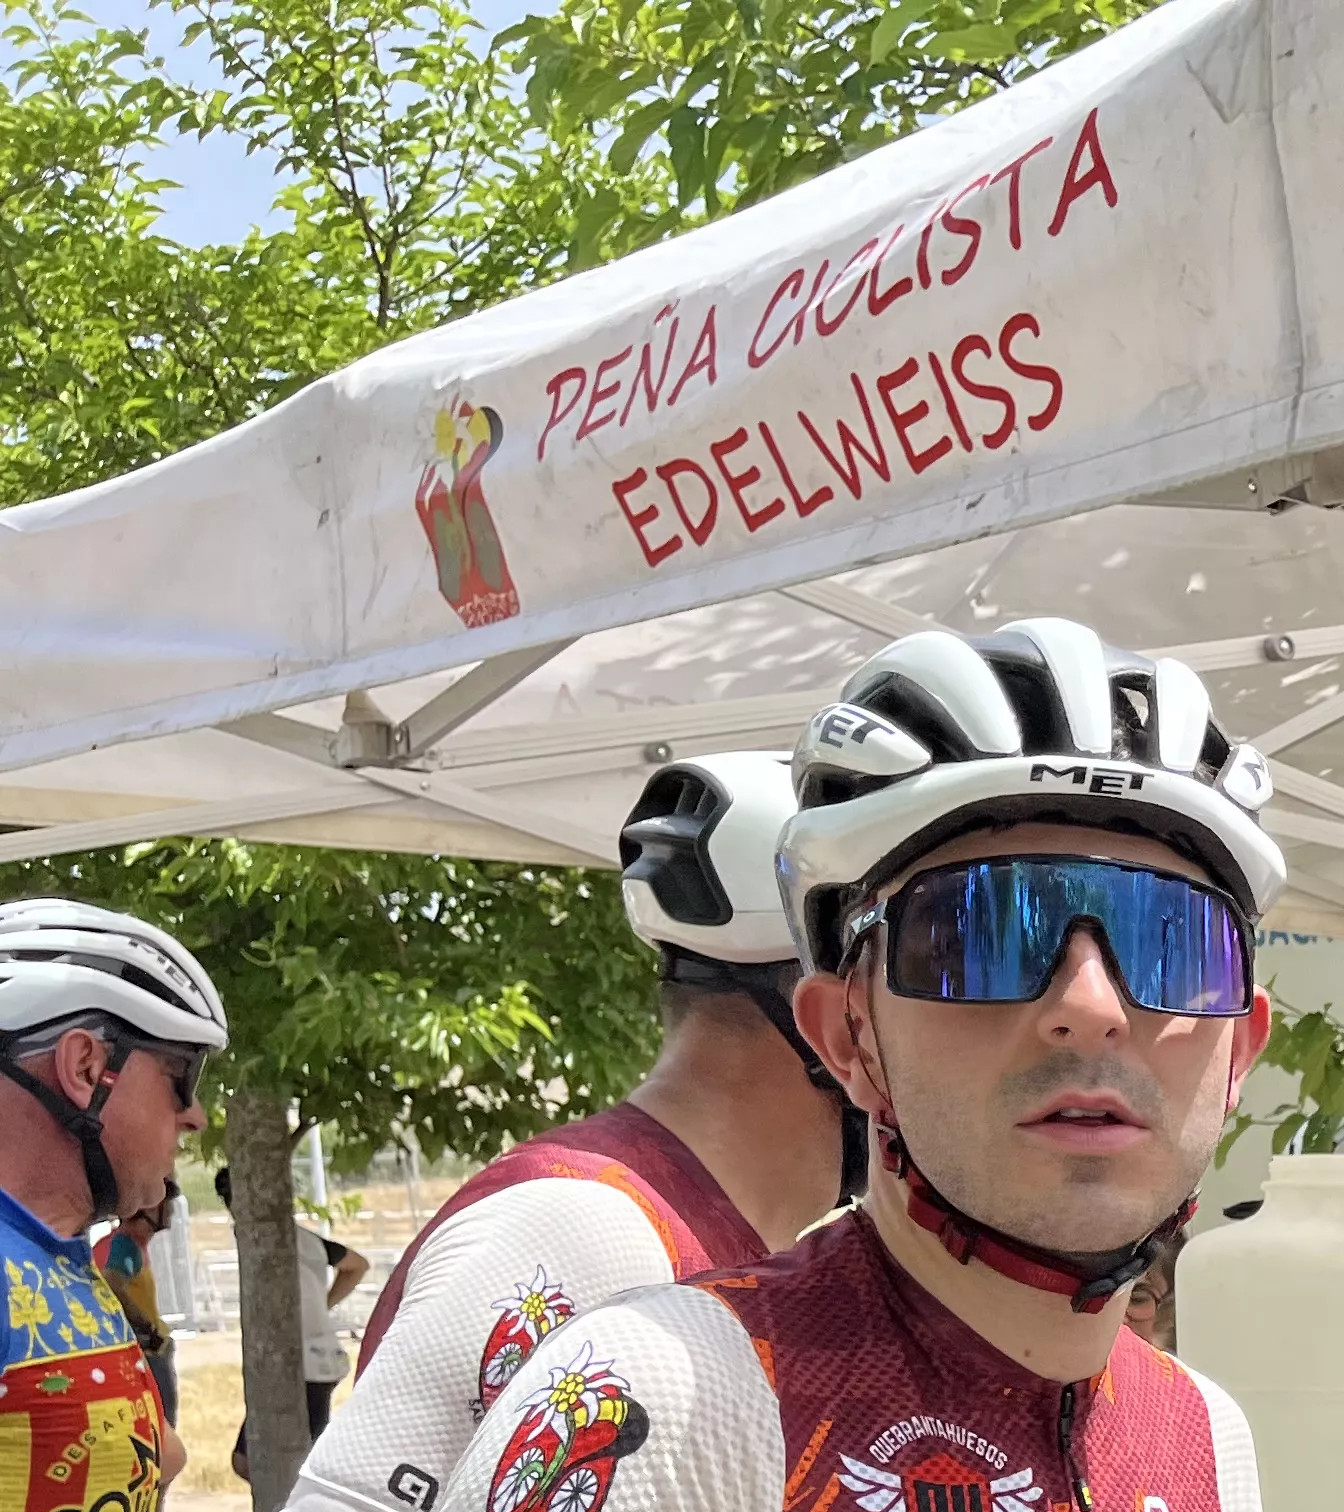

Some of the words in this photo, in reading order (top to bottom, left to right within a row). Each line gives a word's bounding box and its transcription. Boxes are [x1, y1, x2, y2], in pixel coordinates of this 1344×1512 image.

[536, 299, 720, 461] PEÑA
[612, 312, 1065, 567] EDELWEISS
[1029, 763, 1156, 796] MET
[868, 1415, 1008, 1470] QUEBRANTAHUESOS
